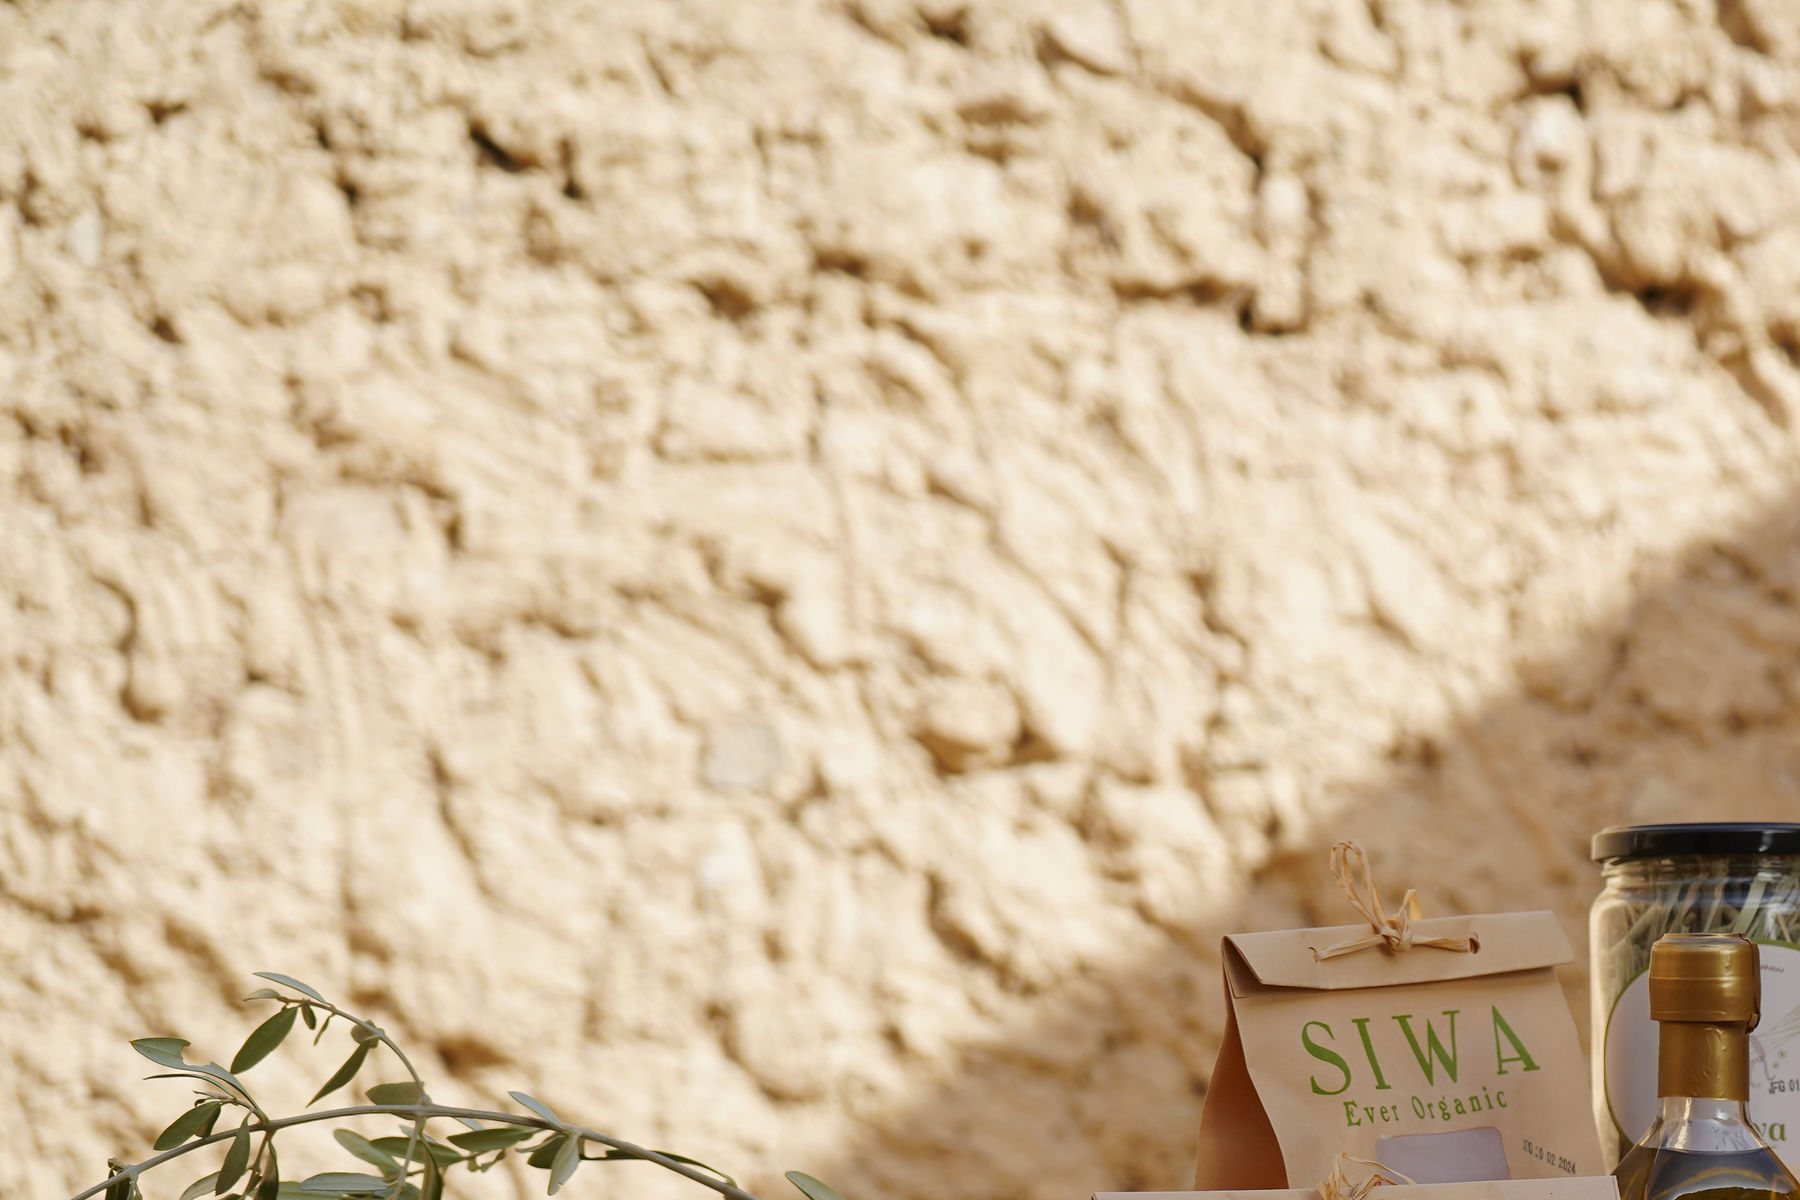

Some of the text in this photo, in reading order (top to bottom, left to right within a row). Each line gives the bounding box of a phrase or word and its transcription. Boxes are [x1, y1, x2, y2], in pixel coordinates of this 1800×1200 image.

[1301, 1004, 1541, 1096] SIWA
[1343, 1085, 1509, 1127] Ever Organic
